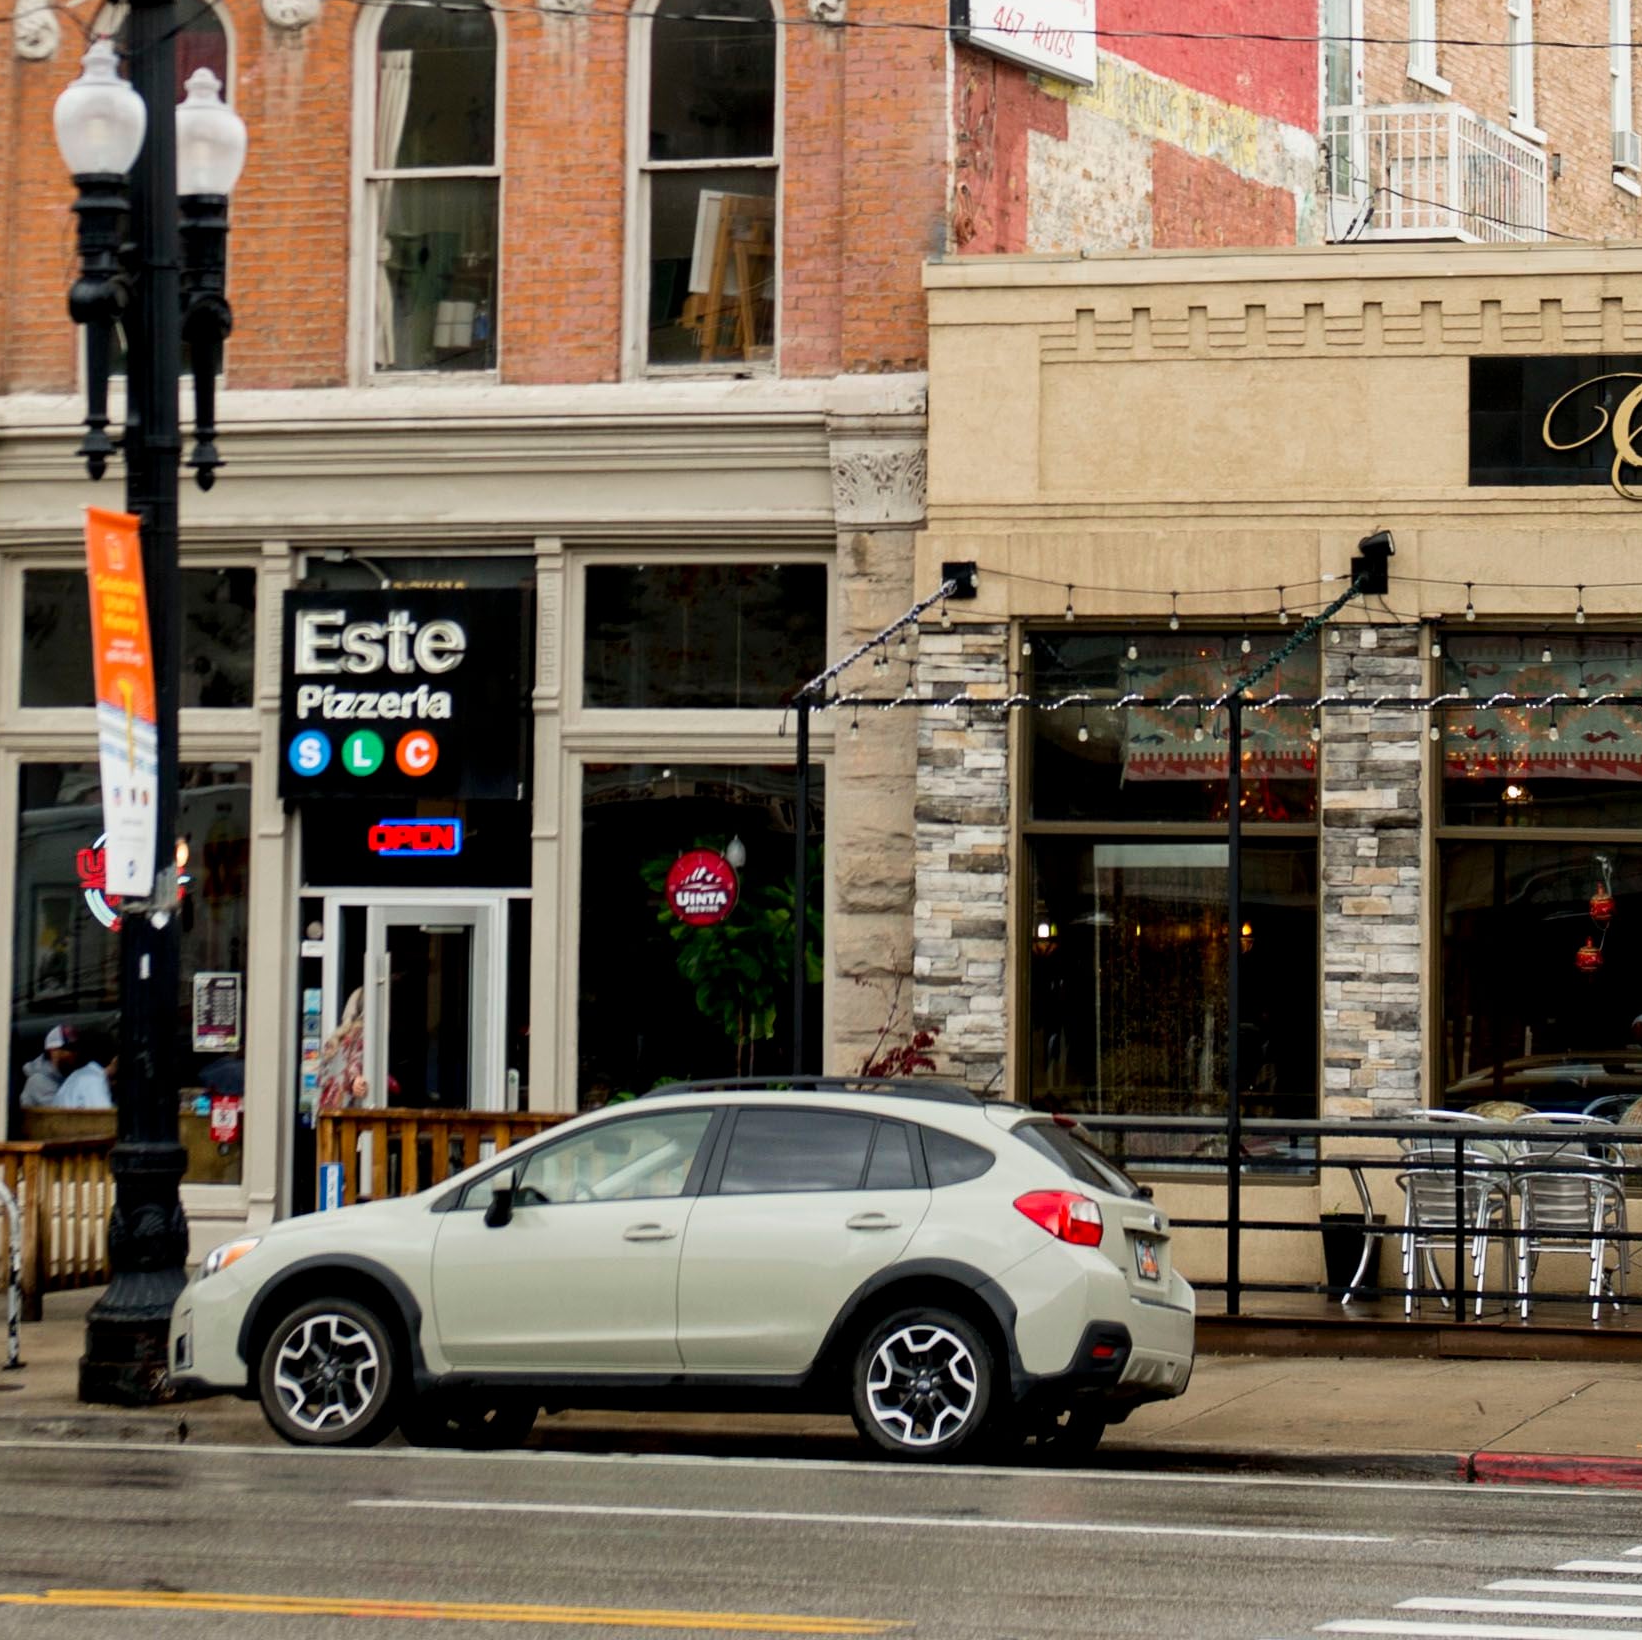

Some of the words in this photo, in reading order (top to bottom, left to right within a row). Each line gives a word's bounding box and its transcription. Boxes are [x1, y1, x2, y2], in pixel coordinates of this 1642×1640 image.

[992, 5, 1025, 40] 467
[1031, 20, 1075, 60] RUGS
[294, 609, 467, 674] Este
[296, 684, 452, 719] Pizzeria
[298, 737, 322, 769] S
[352, 738, 373, 768] L
[405, 737, 430, 769] C
[367, 823, 455, 851] OPEN
[675, 891, 727, 906] UINTA
